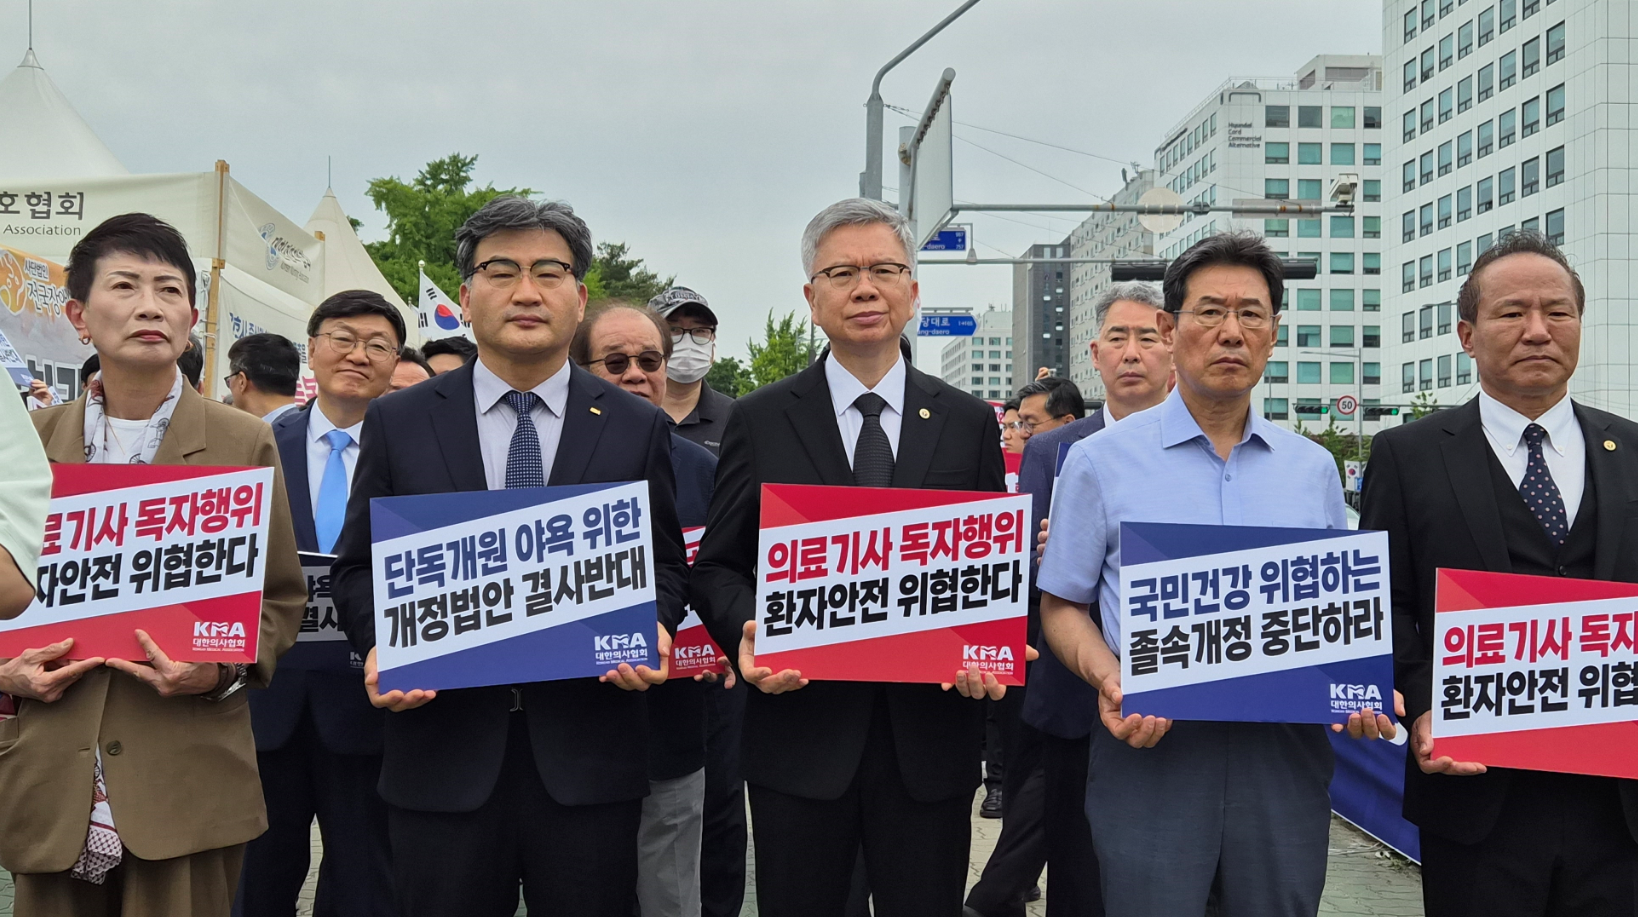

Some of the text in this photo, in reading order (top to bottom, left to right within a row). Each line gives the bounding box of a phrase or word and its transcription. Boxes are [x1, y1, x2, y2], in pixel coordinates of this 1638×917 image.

[0, 190, 85, 221] 호협회
[3, 224, 81, 236] Association
[1341, 400, 1353, 410] 50
[135, 482, 264, 542] 독자행위
[384, 496, 642, 600] 단독개원 야욕 위한
[765, 526, 893, 585] 의료기사
[899, 508, 1024, 566] 독자행위
[129, 532, 260, 594] 위협한다
[383, 544, 648, 649] 개정법안 결사반대
[763, 559, 1023, 638] 환자안전 위협한다
[1128, 548, 1382, 623] 국민건강 위협하는
[192, 638, 246, 648] 대한의사협회
[193, 621, 246, 638] KMA
[594, 632, 648, 651] KMA
[1129, 596, 1385, 677] 졸속개정 중단하라
[1442, 615, 1572, 669] 의료기사
[595, 648, 648, 661] 대한의사협회
[674, 644, 715, 659] KMA
[675, 656, 716, 667] 대한의사협회
[963, 645, 1014, 661] KMA
[1330, 683, 1383, 700] KMA
[1441, 666, 1570, 721] 환자안전
